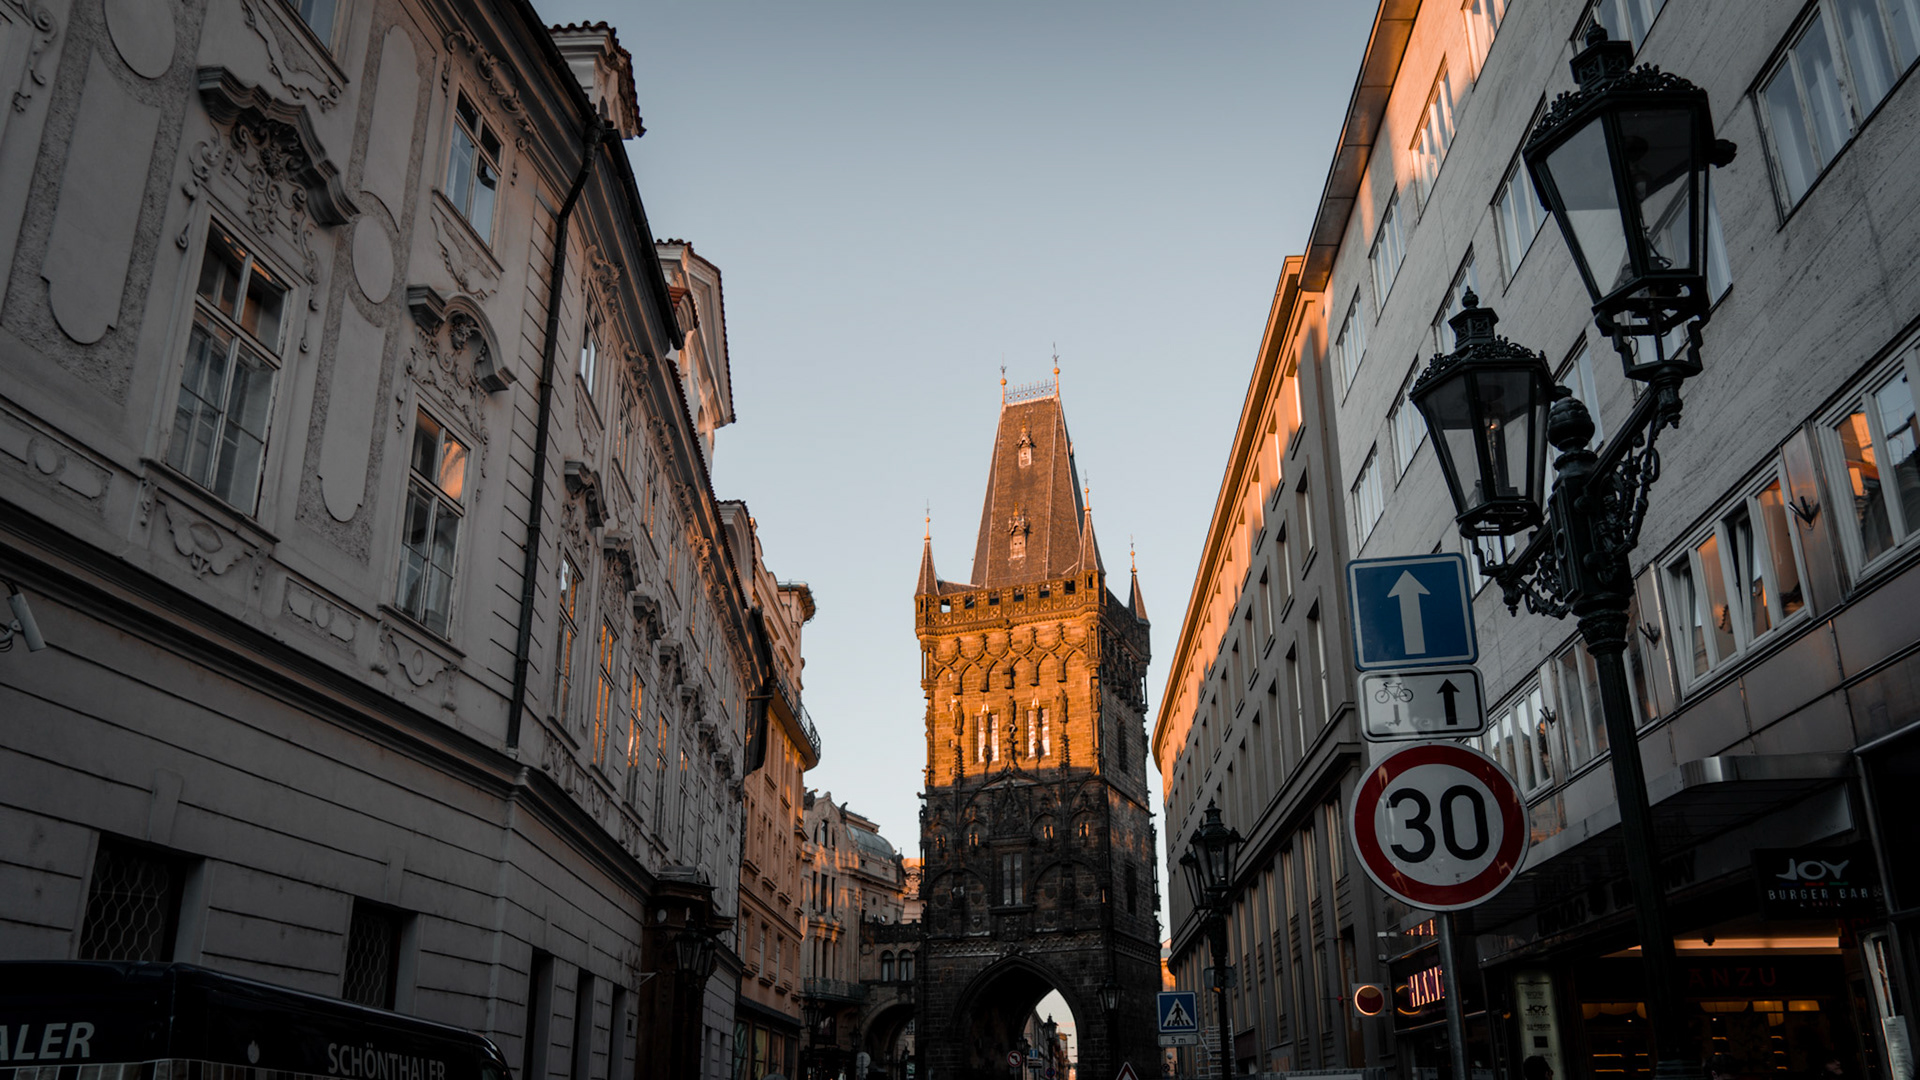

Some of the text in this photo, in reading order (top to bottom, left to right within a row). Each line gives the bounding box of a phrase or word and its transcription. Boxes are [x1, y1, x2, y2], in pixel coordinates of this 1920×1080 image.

[1385, 784, 1490, 864] 30
[1775, 857, 1850, 881] JOY
[1767, 887, 1869, 901] BURGER BAR
[1687, 966, 1777, 989] ANZU
[327, 1041, 446, 1080] SCHÖNTHALER
